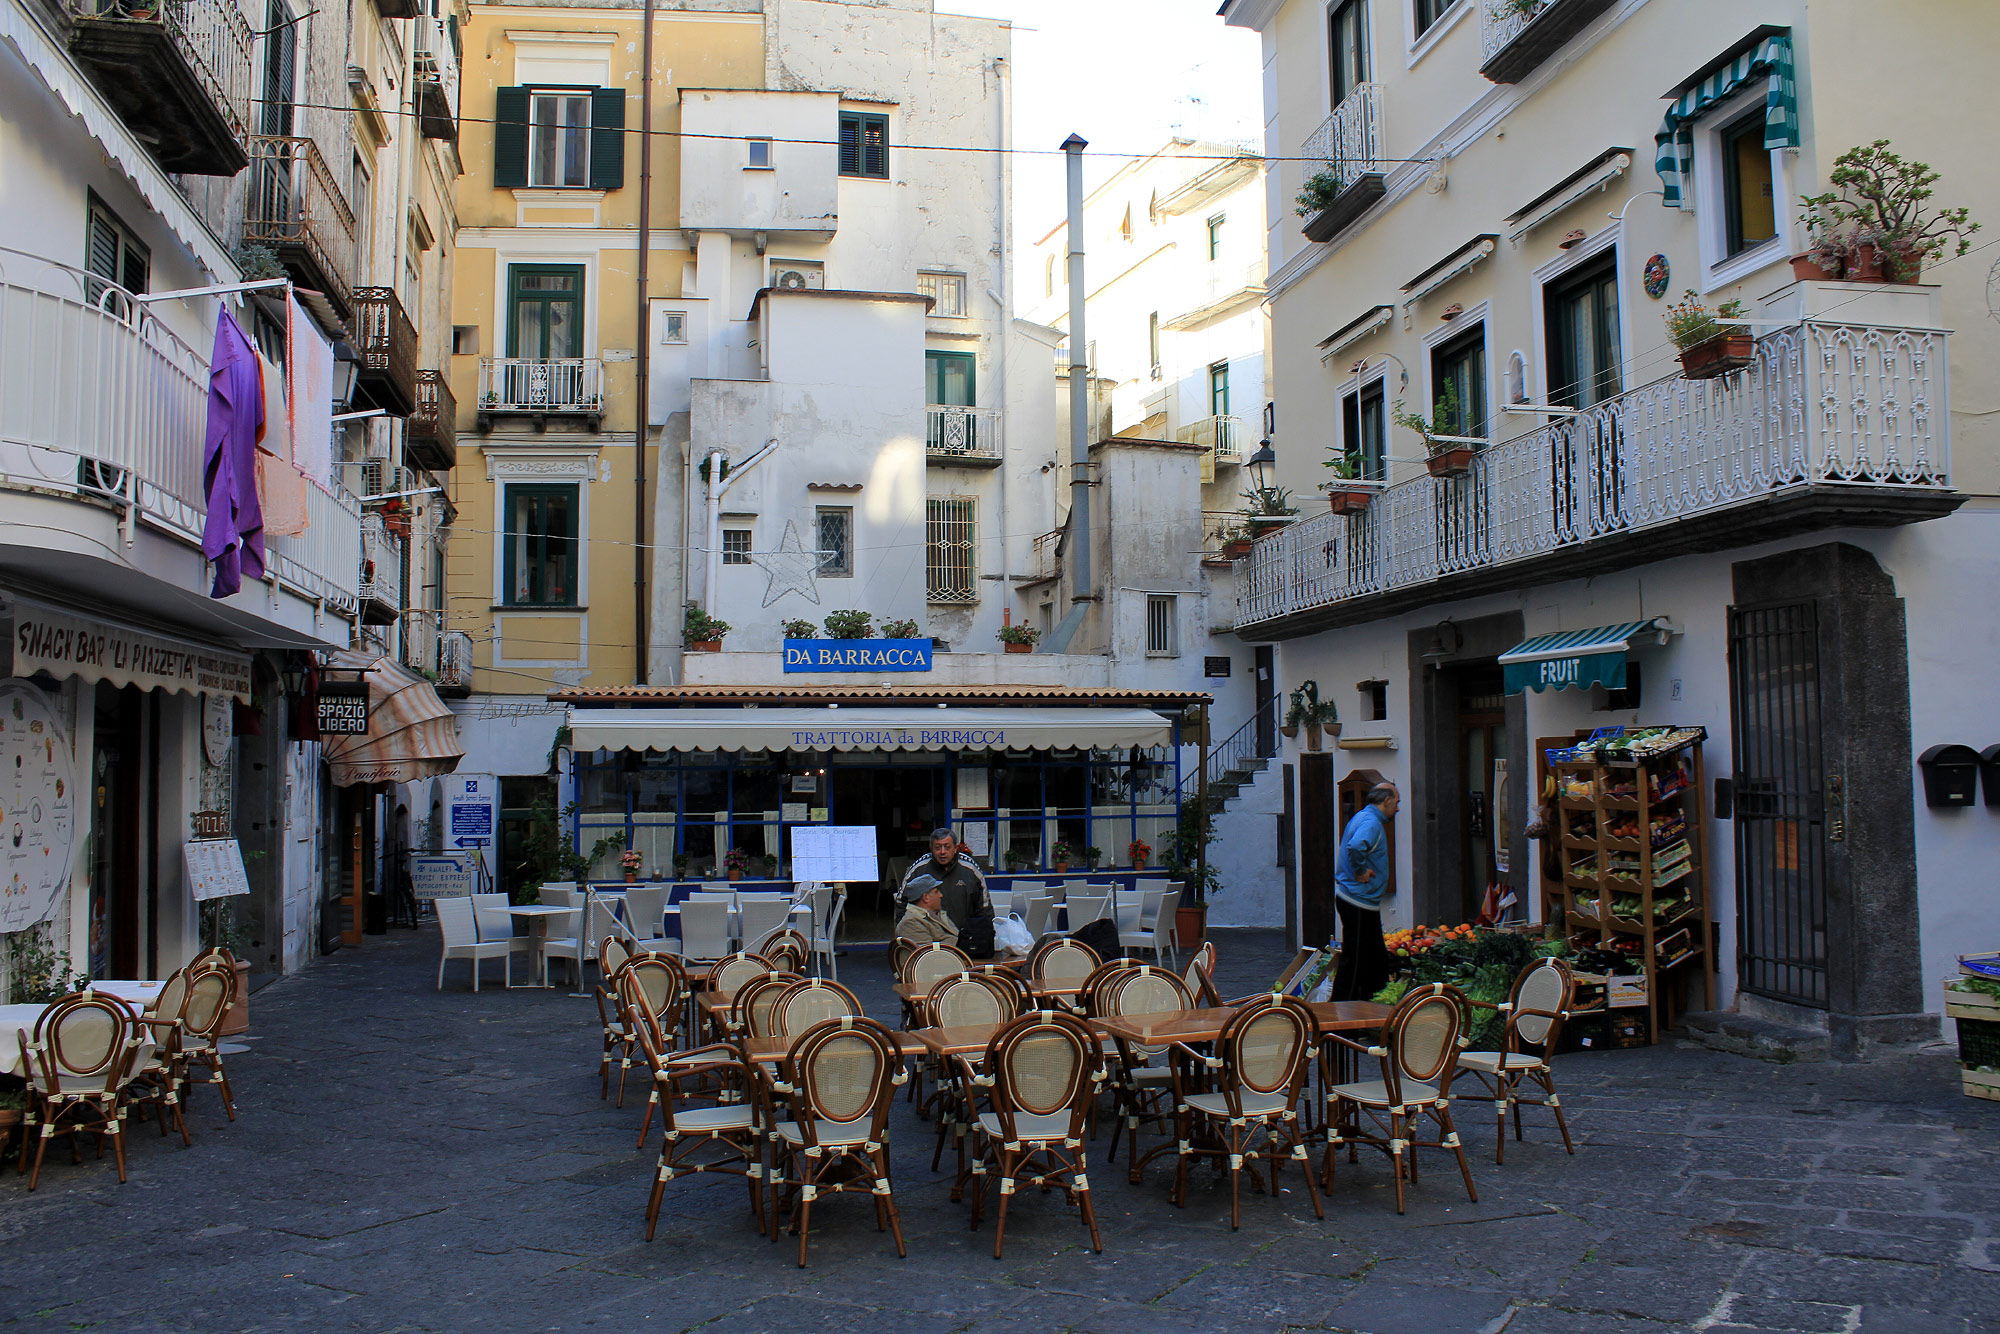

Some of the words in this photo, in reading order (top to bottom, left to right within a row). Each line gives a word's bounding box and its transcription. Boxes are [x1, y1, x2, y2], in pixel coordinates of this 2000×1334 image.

[18, 621, 73, 661] SNACK
[75, 630, 105, 667] BAR
[786, 648, 813, 665] DA
[818, 648, 927, 666] BARRACCA
[1540, 658, 1581, 684] FRUIT
[319, 696, 365, 705] BOUTIQUE
[318, 704, 366, 718] SPAZIO
[318, 718, 366, 732] LIBERO
[792, 731, 893, 745] TRATTORIA
[898, 730, 914, 745] da
[920, 730, 1004, 745] BARRACCA
[339, 764, 401, 782] Panificio
[196, 816, 227, 832] PIZZA
[429, 865, 452, 873] AMALFI
[412, 874, 435, 882] SERVIZI
[440, 874, 470, 882] EXPRESS
